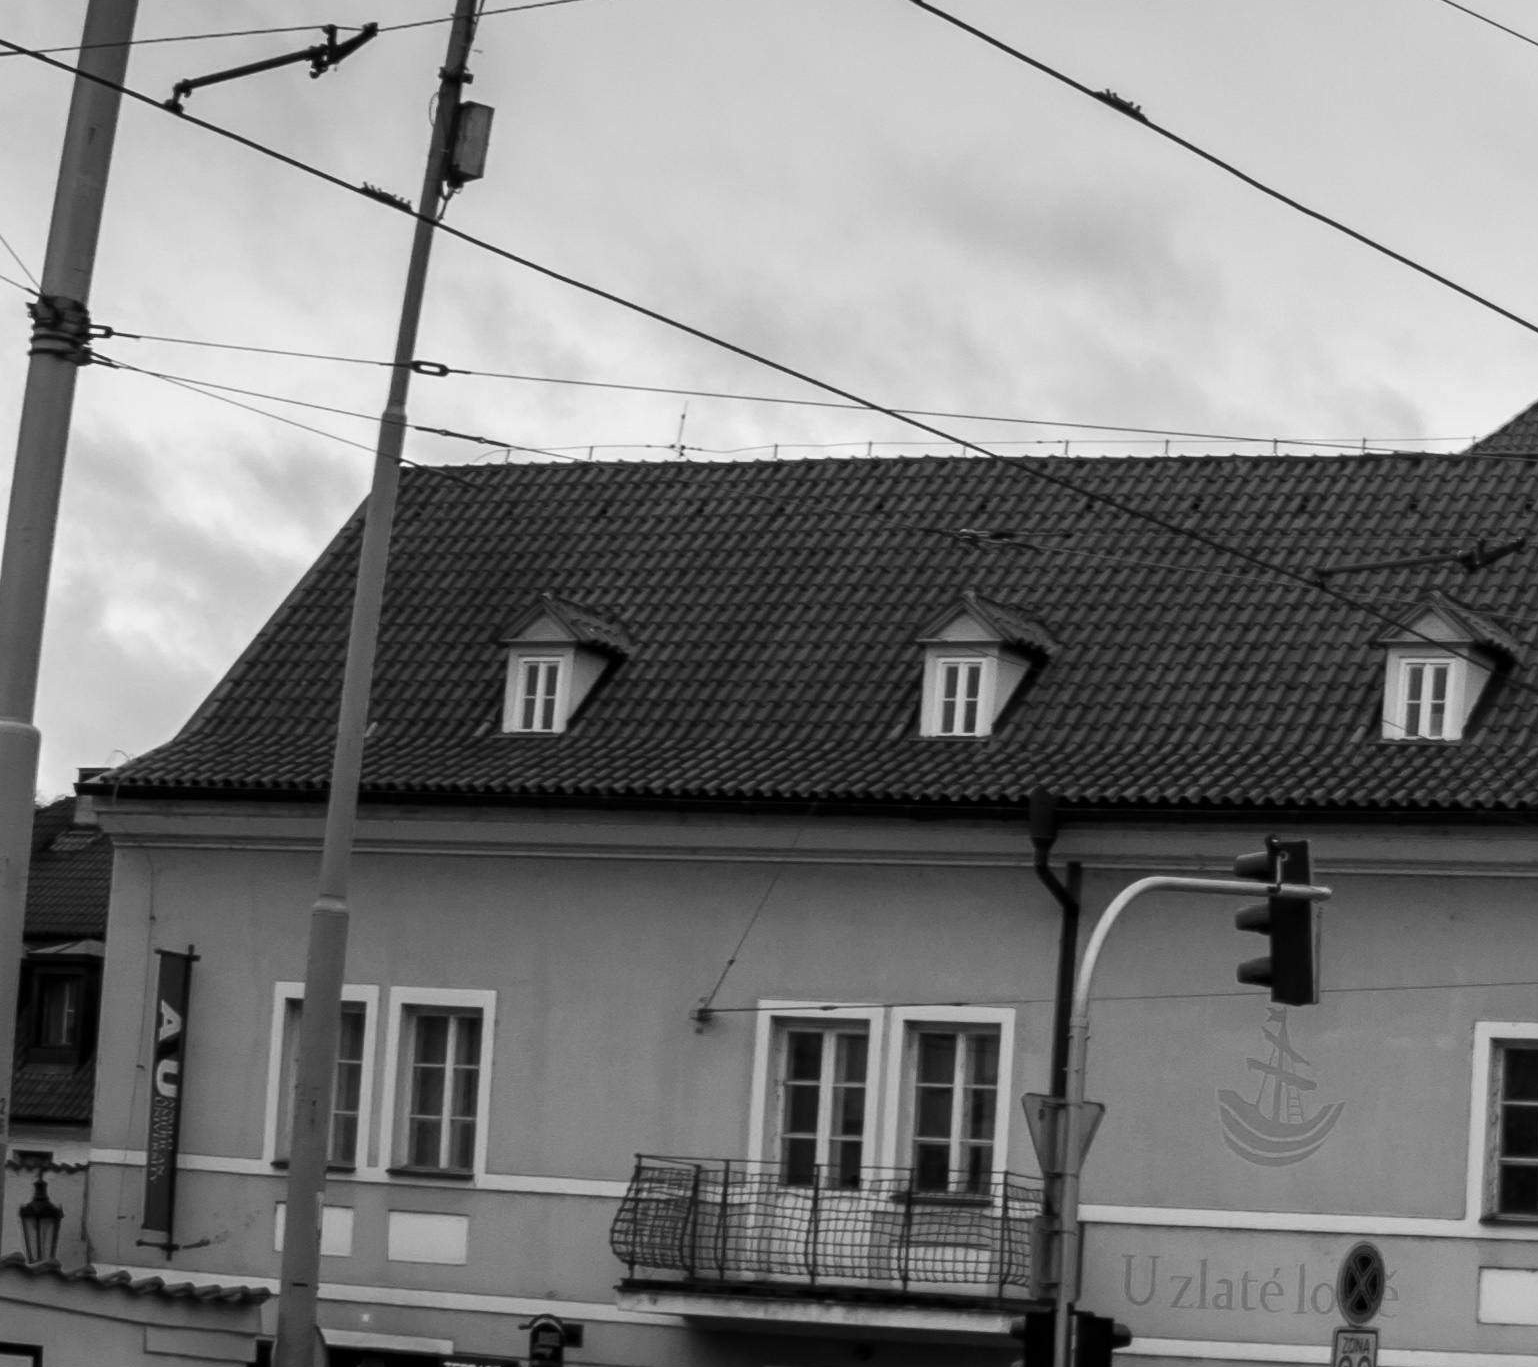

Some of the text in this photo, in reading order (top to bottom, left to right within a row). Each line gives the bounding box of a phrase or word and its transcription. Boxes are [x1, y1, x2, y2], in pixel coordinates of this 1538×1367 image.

[157, 999, 182, 1098] AU
[1121, 1254, 1400, 1318] U zlaté loě
[1342, 1337, 1370, 1354] ZONA
